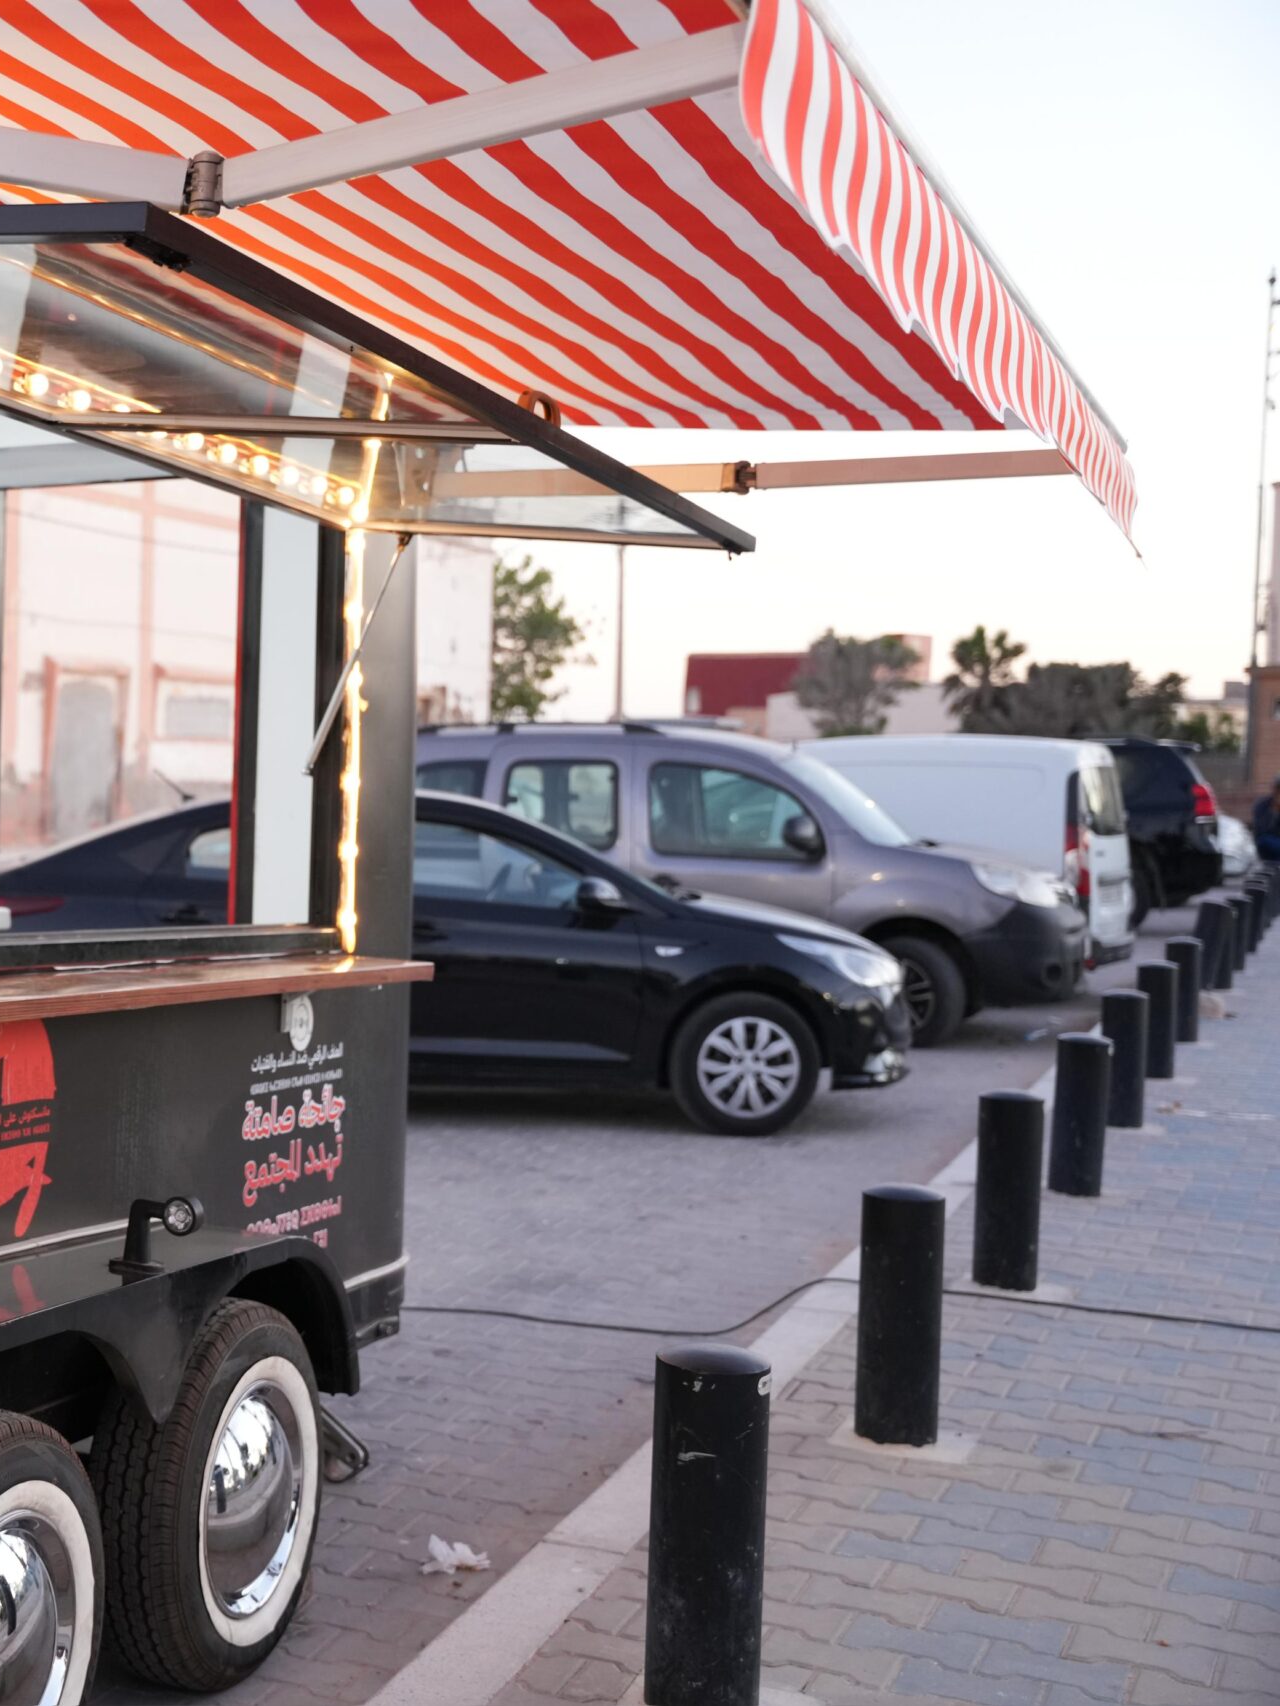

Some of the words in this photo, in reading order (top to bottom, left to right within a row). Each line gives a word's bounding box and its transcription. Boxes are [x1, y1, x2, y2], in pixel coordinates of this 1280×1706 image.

[242, 1094, 296, 1141] صامتة
[243, 1138, 302, 1208] المجتمع
[304, 1133, 344, 1182] تهدد
